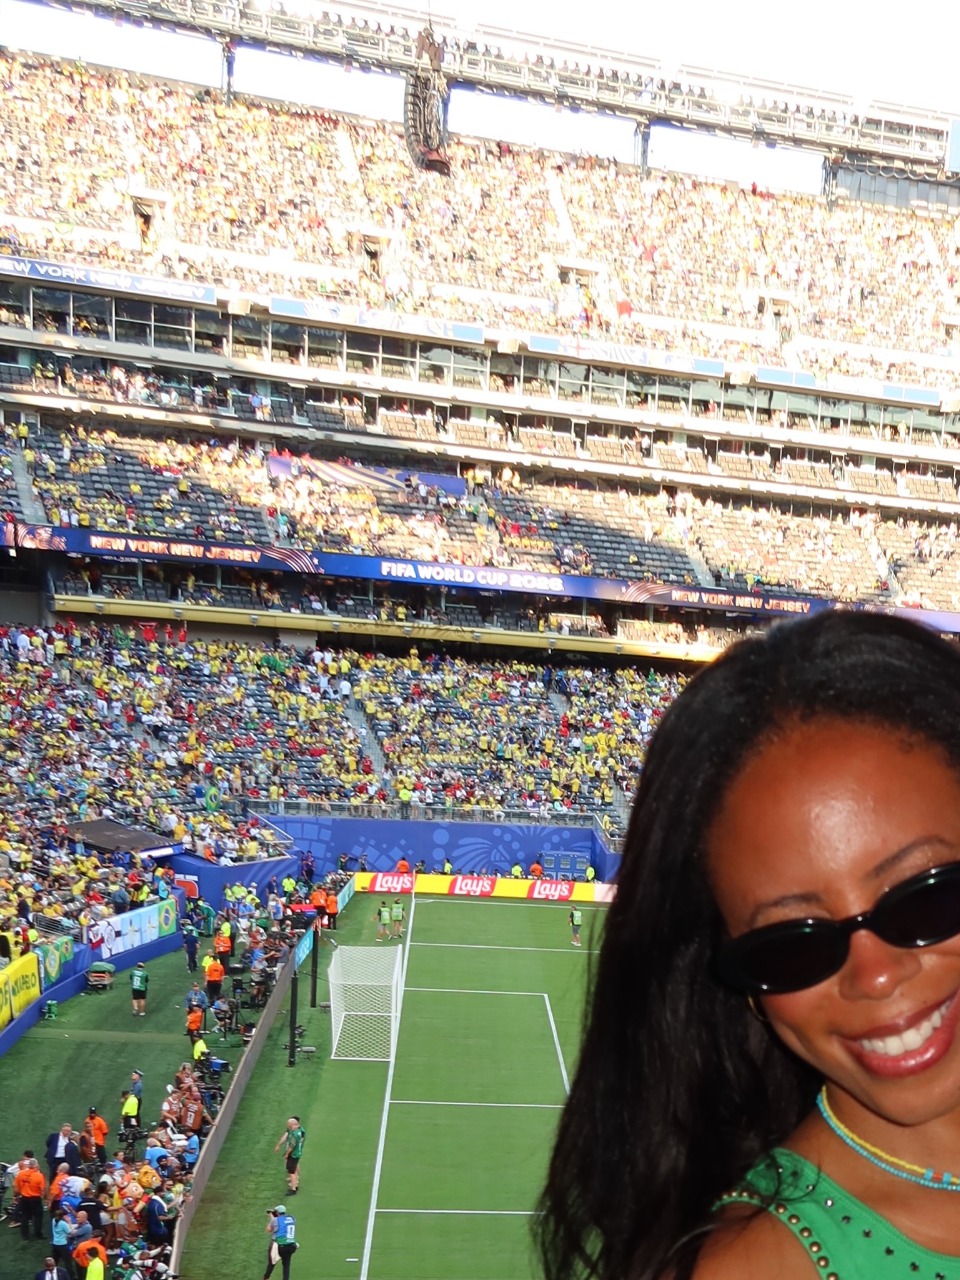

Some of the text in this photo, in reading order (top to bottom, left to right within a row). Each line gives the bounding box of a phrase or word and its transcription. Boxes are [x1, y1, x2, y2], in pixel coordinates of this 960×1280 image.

[34, 263, 87, 283] YORK
[89, 270, 132, 289] NEW
[89, 535, 262, 563] NEW YORK NEW JERSEY
[381, 561, 565, 591] FIFA WORLD CUP 2026
[671, 590, 811, 614] NEW YORK NEW JERSEY
[374, 874, 412, 894] Lay's
[454, 877, 491, 896] Lay's
[533, 880, 570, 898] Lay's
